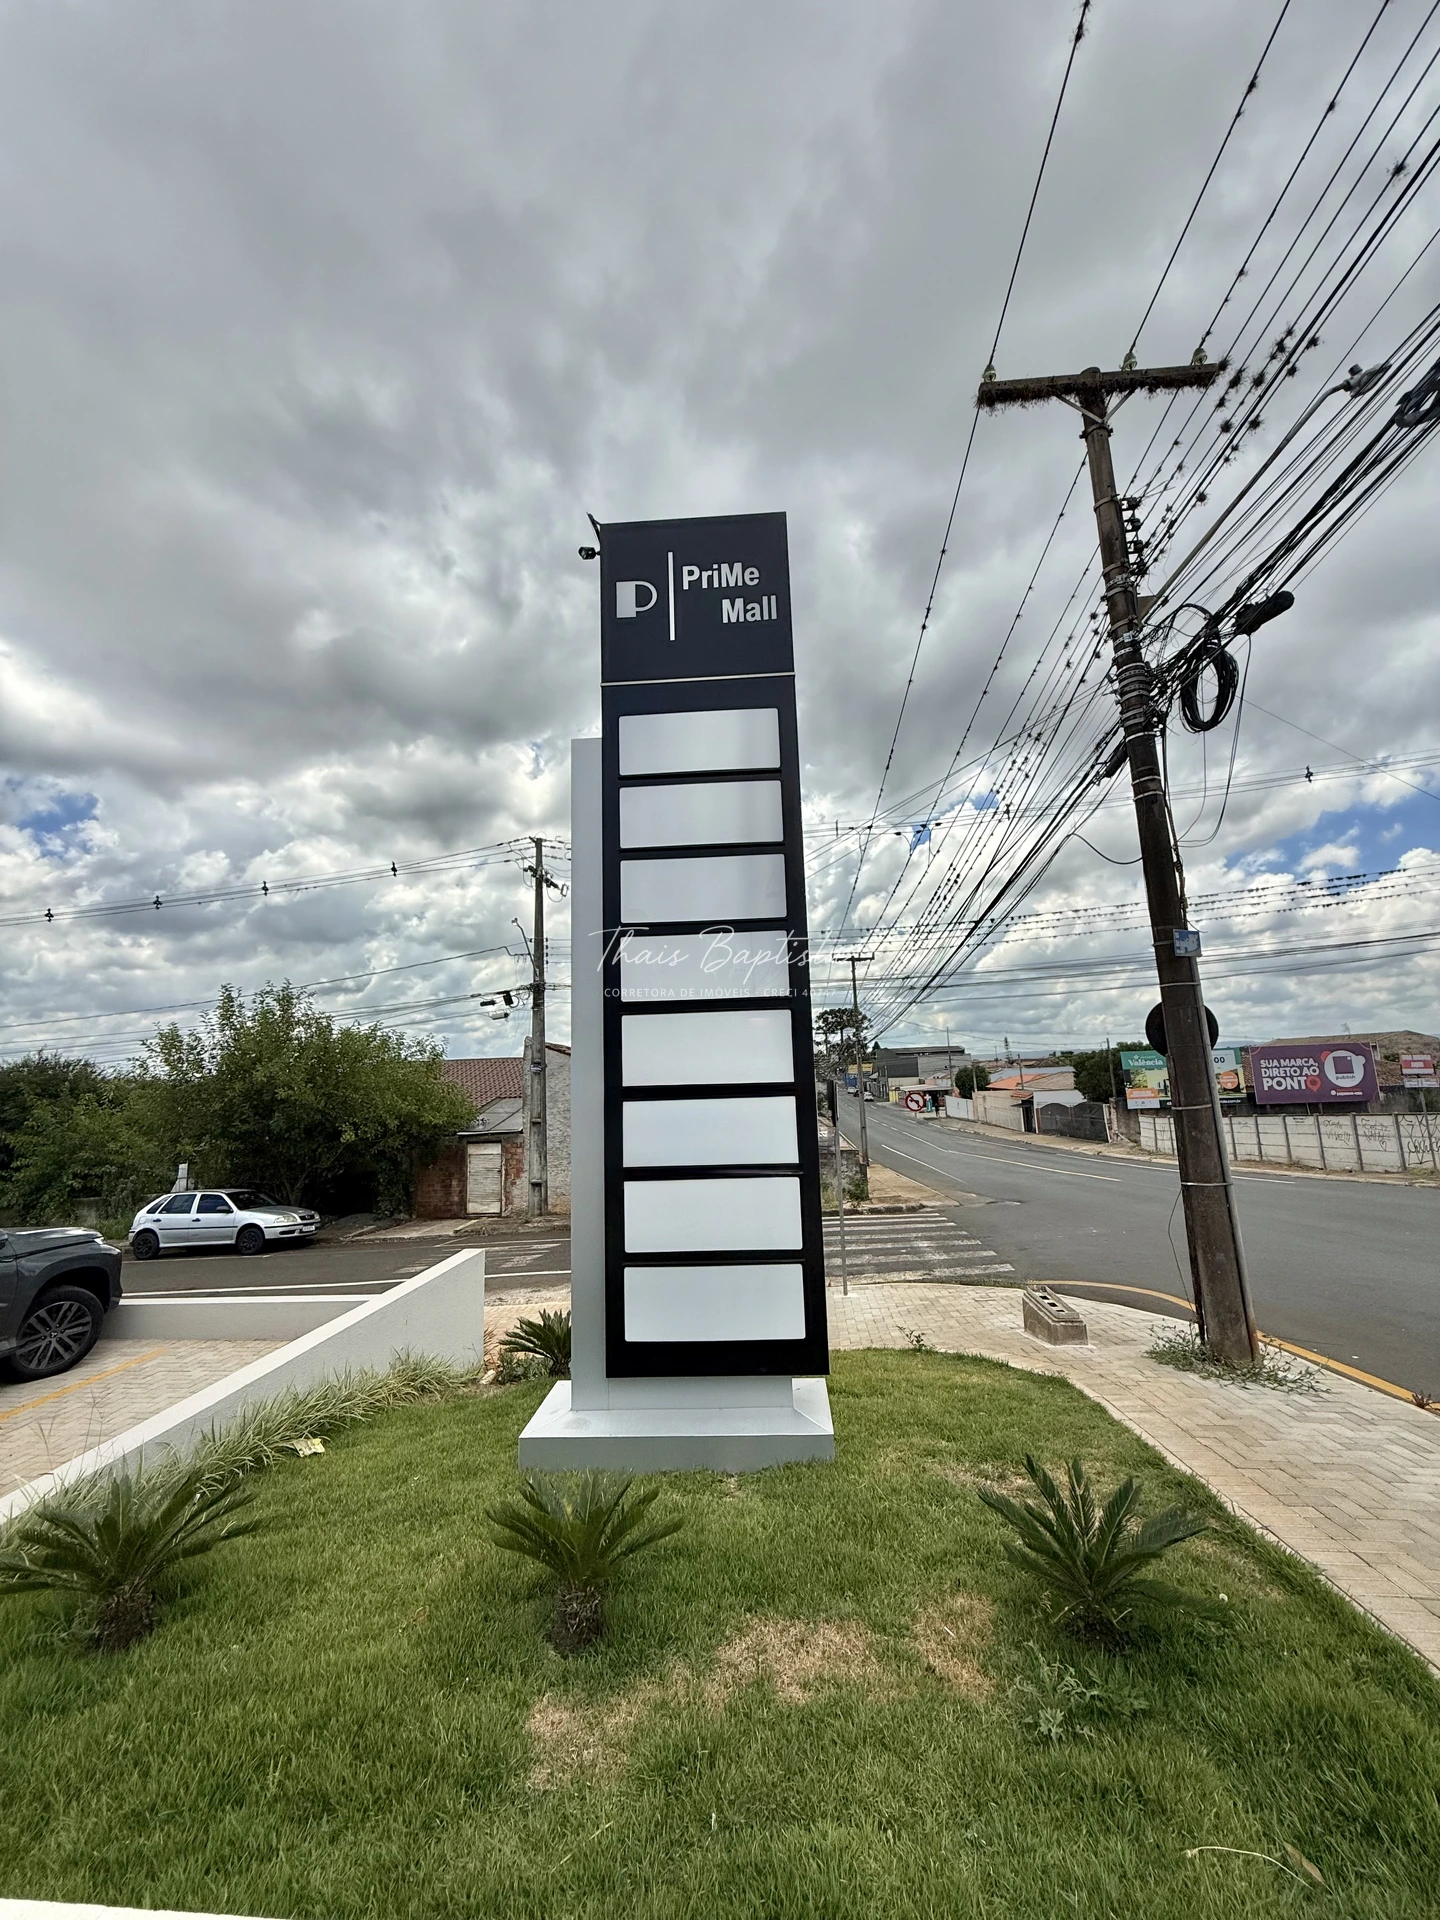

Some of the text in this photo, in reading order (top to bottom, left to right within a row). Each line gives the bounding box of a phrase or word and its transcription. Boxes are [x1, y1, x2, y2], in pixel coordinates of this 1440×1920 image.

[682, 562, 760, 590] PriMe
[721, 594, 778, 624] Mall
[1260, 1058, 1319, 1068] SUA MARCA,
[1261, 1066, 1319, 1077] DIRETO AO
